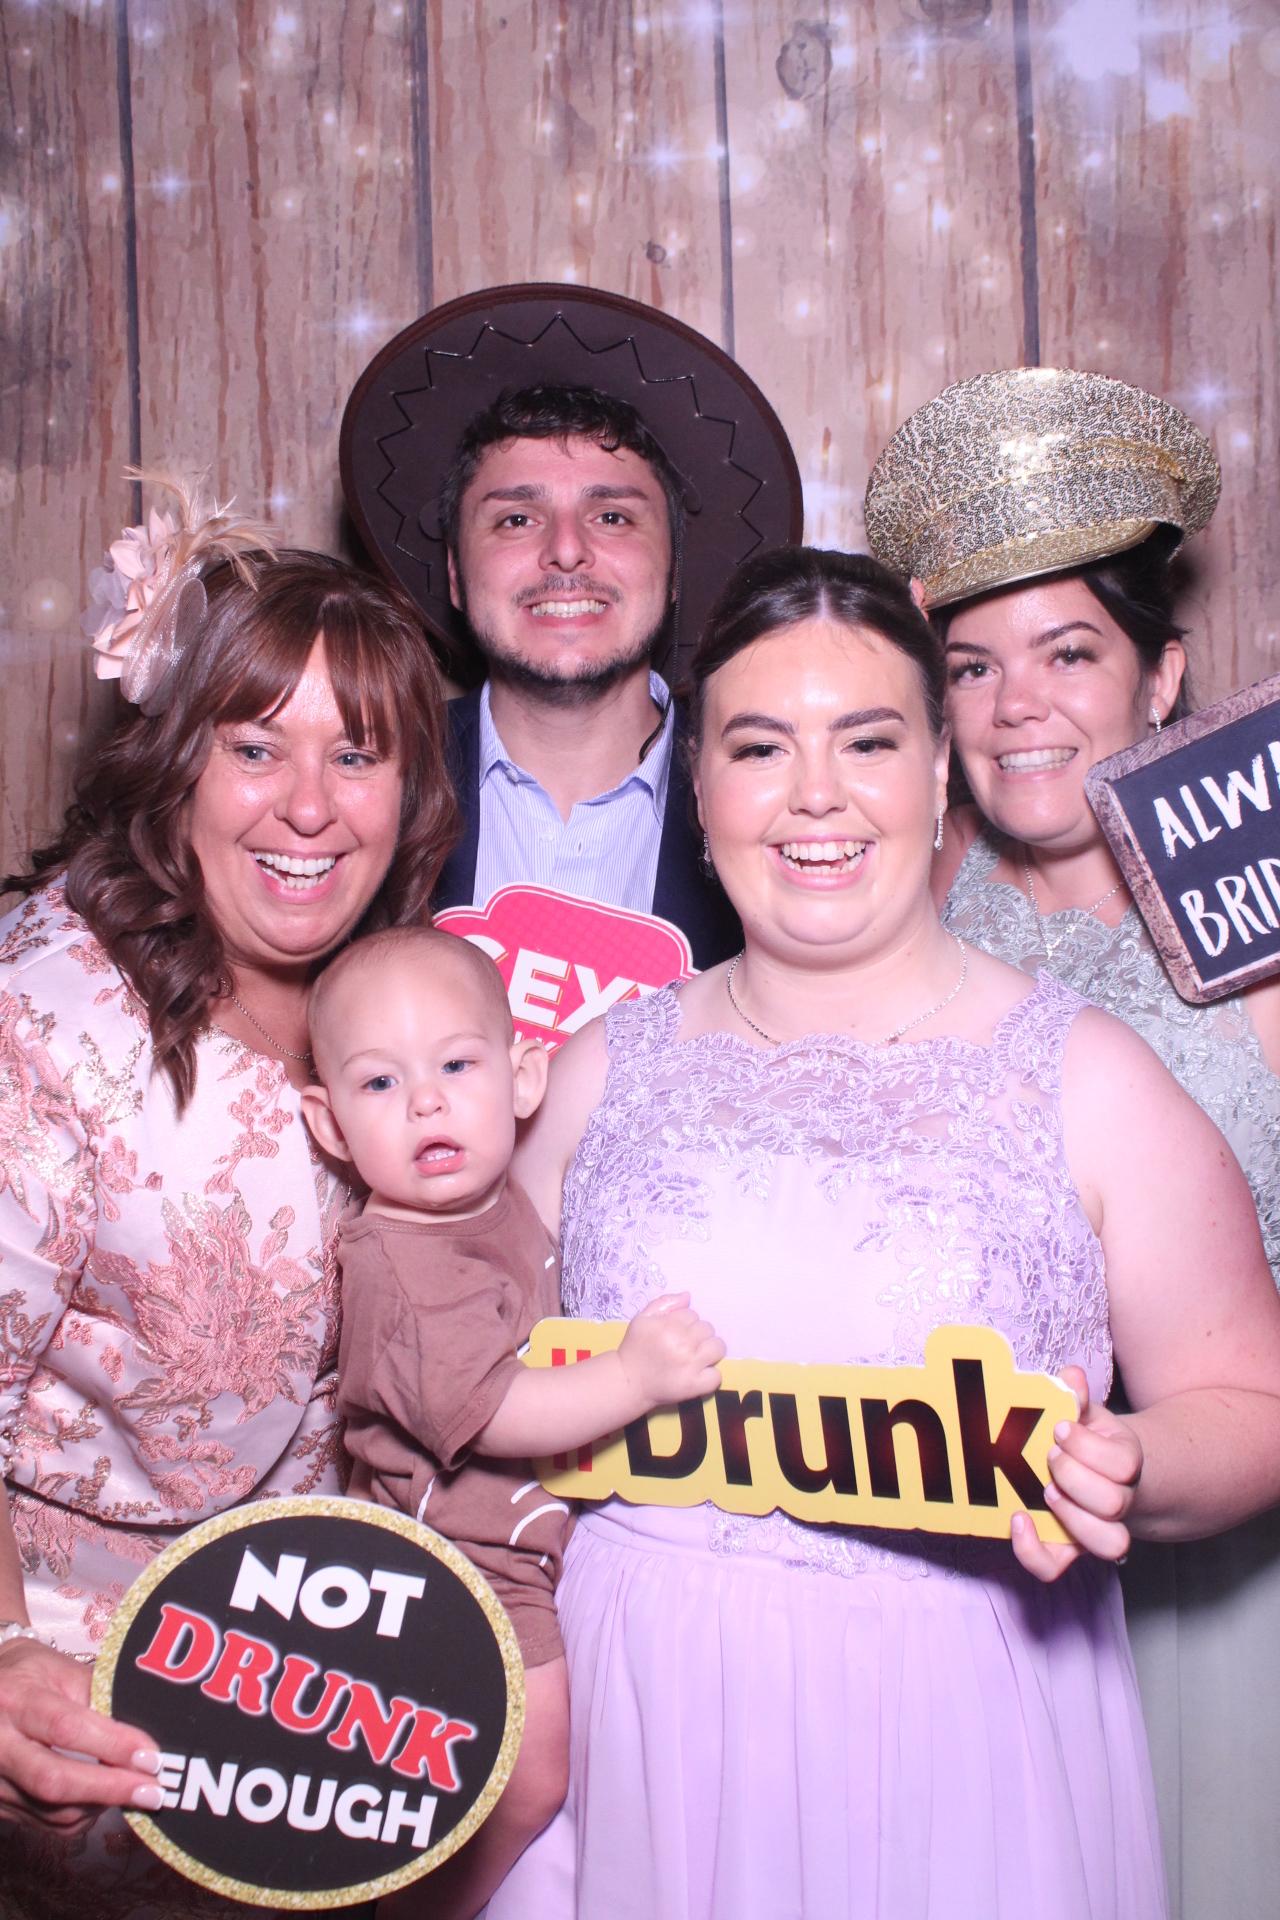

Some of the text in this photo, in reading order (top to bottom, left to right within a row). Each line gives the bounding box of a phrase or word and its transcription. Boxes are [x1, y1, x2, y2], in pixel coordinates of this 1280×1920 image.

[1153, 741, 1280, 860] ALW
[229, 1548, 427, 1638] NOT
[135, 1602, 478, 1791] DRUNK
[157, 1752, 439, 1849] ENOUGH
